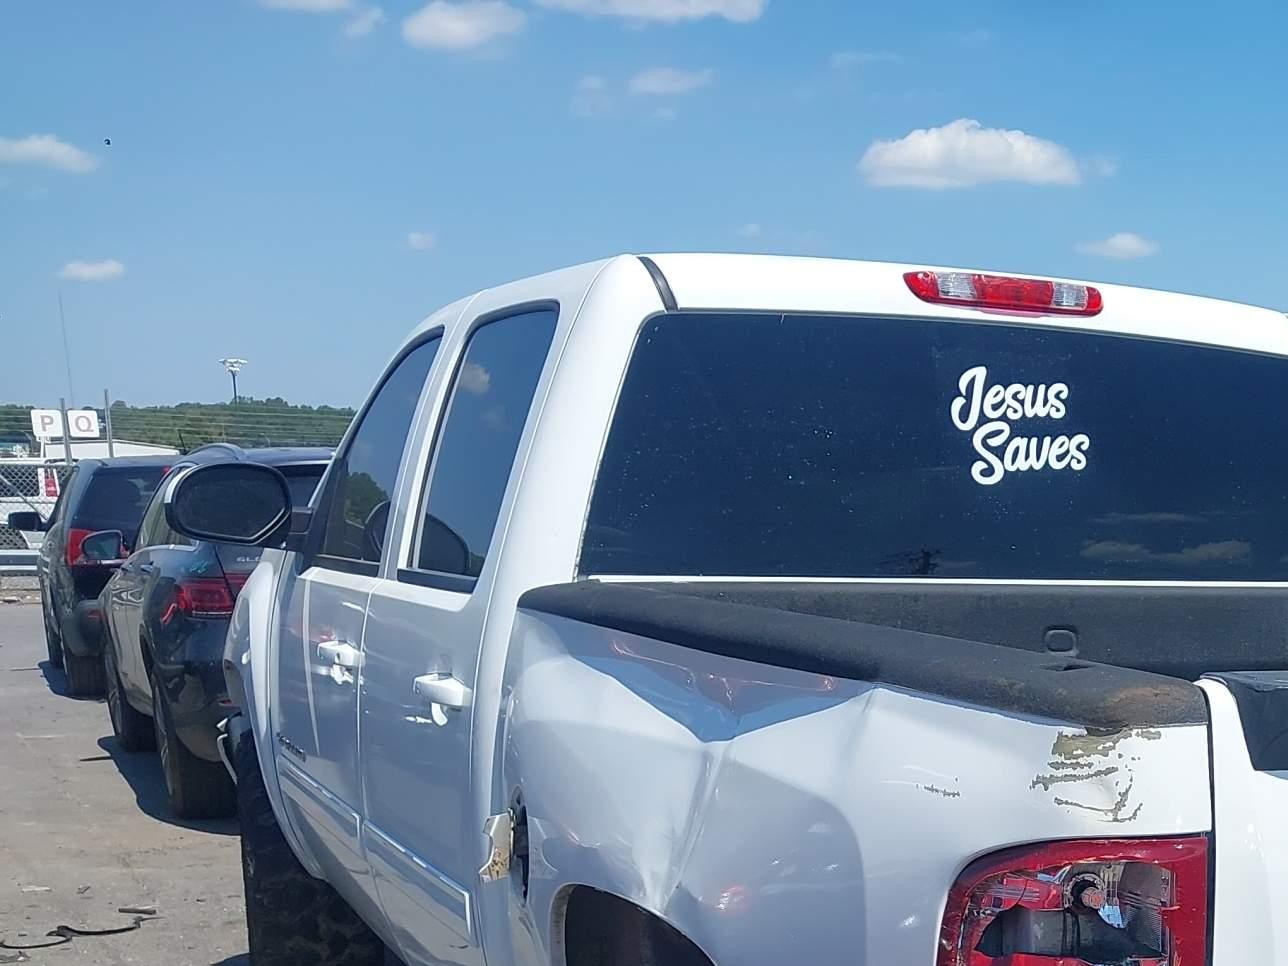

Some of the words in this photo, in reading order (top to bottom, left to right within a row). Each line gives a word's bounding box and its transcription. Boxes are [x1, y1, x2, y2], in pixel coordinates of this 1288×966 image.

[951, 366, 1069, 431] Jesus
[40, 414, 54, 432] P
[75, 415, 95, 432] Q
[971, 421, 1090, 485] Saves
